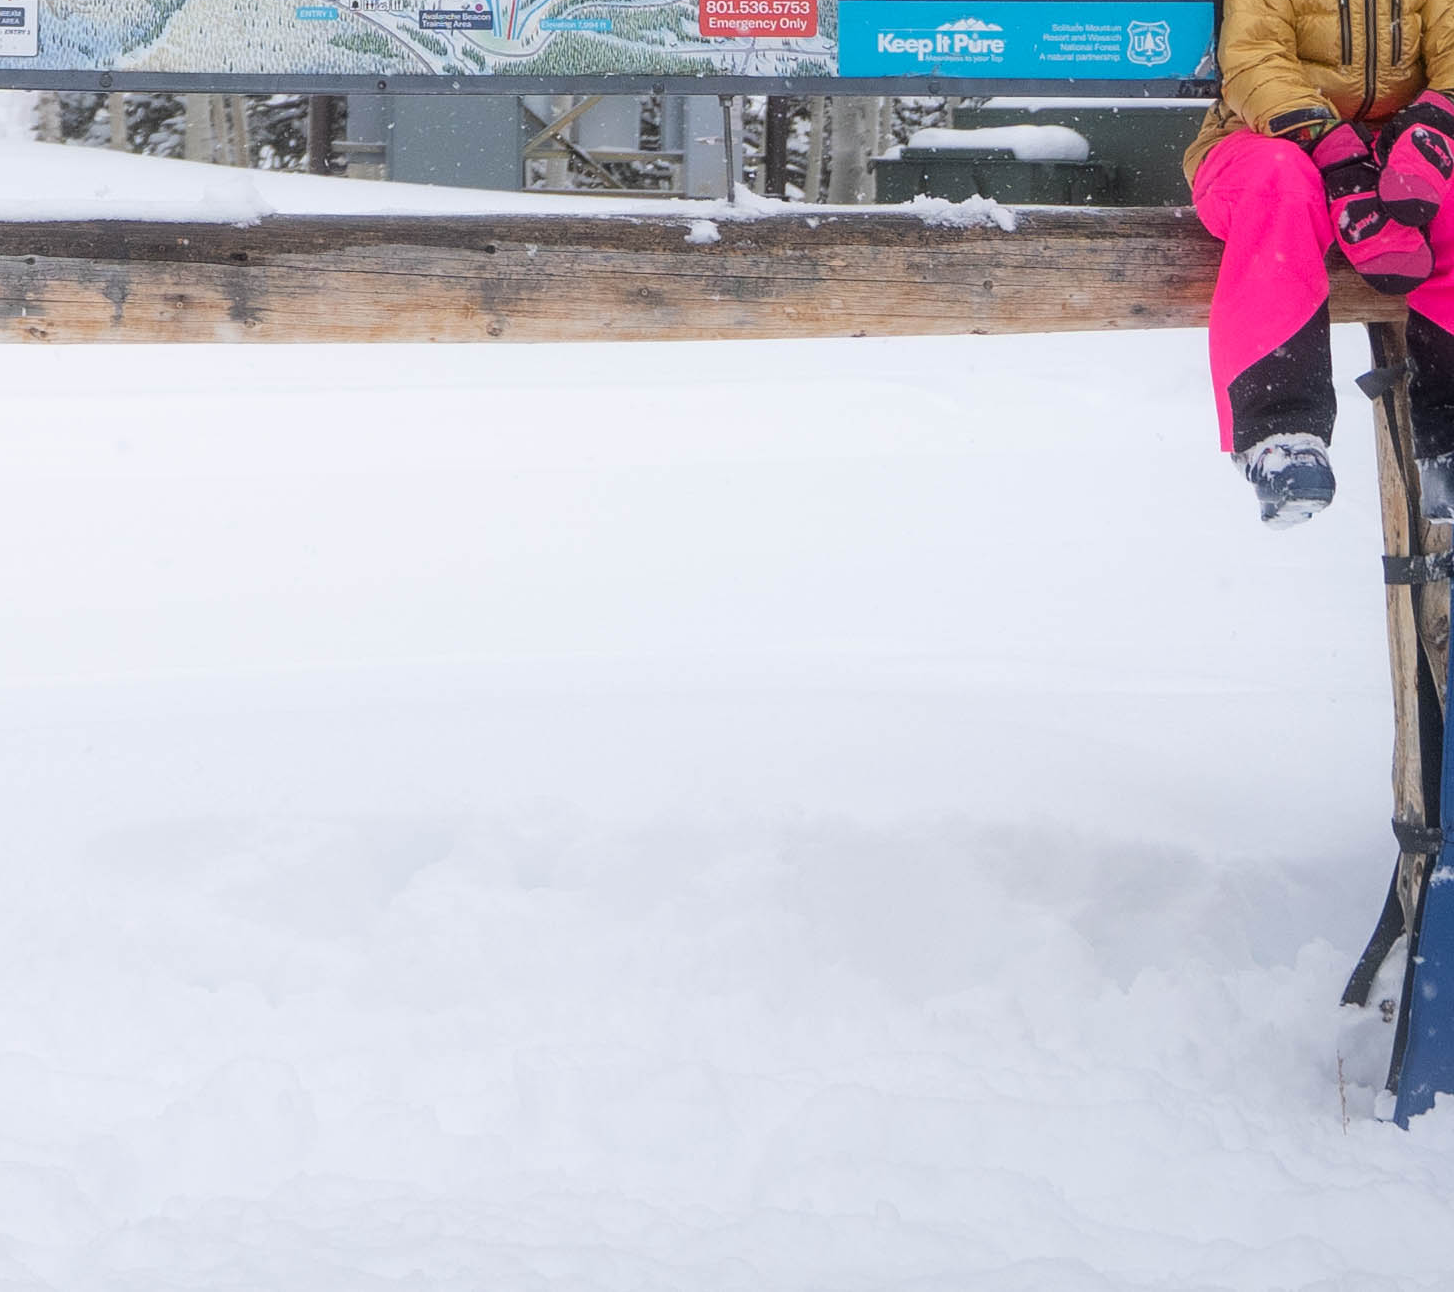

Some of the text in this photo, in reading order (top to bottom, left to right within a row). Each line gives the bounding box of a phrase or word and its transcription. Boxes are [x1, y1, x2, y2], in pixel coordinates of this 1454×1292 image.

[706, 0, 810, 14] 801.536.5753
[708, 17, 807, 32] Emergency Only
[877, 32, 1006, 55] Keep It Pure
